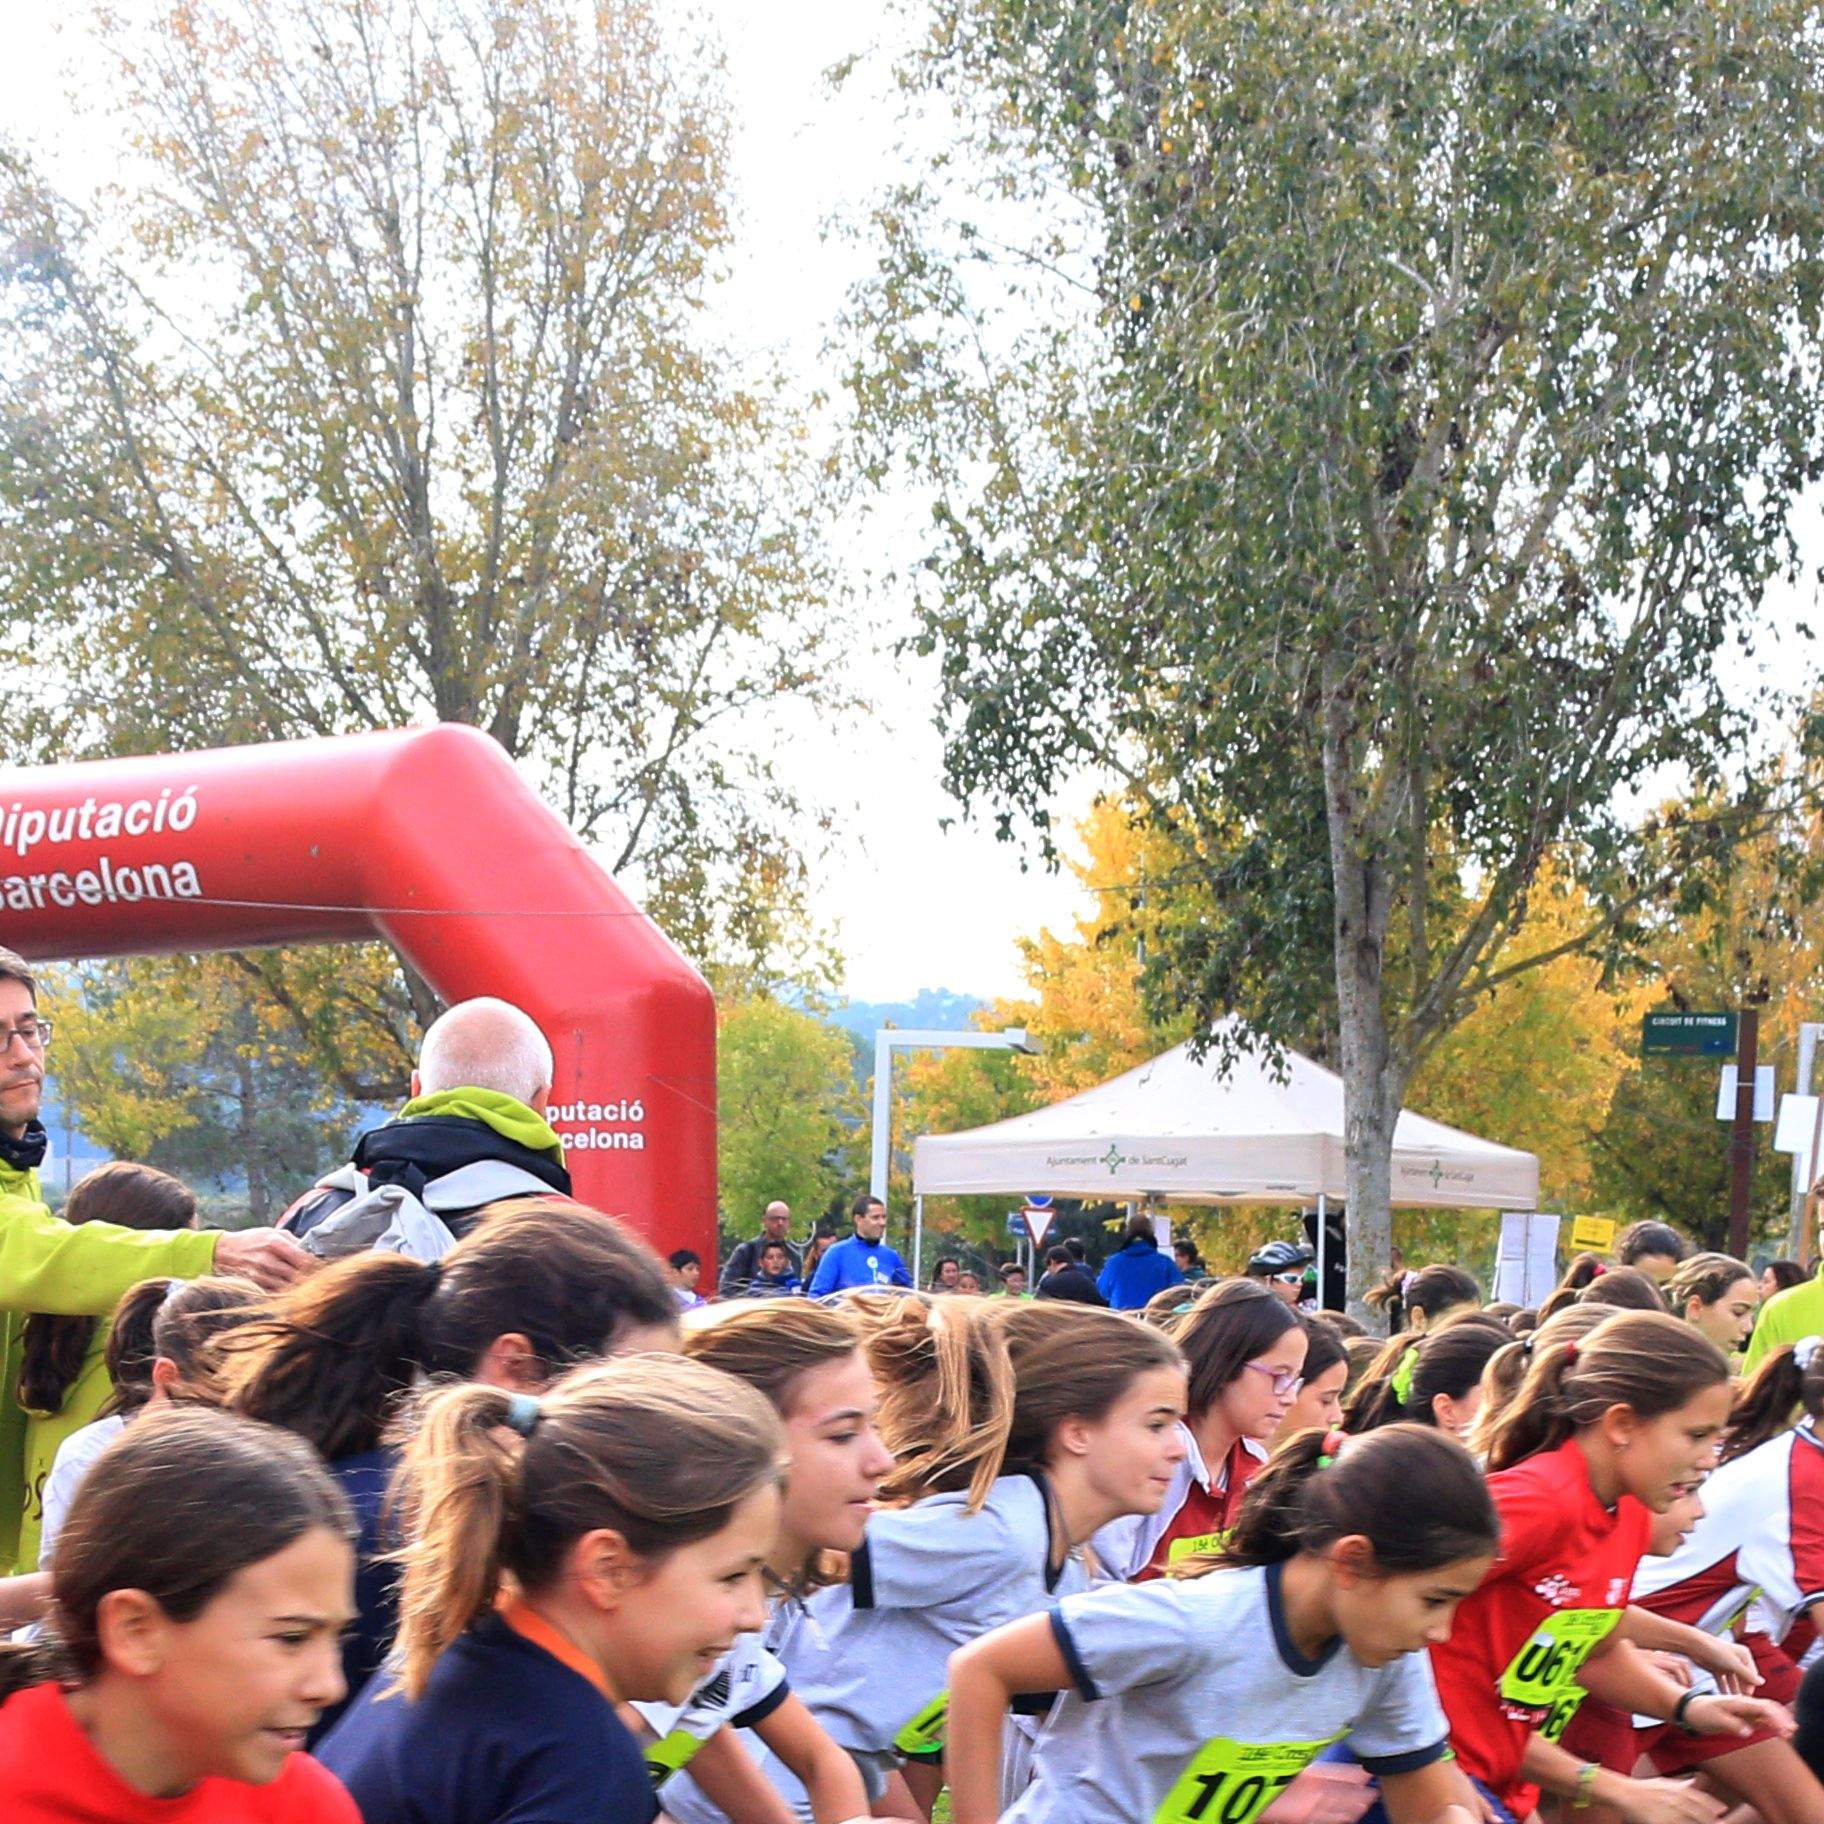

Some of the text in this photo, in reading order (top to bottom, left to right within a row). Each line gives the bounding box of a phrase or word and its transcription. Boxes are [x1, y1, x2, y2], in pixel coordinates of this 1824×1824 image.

[546, 1099, 644, 1124] putació
[1046, 1156, 1097, 1167] Ajuntament
[1129, 1157, 1140, 1165] de
